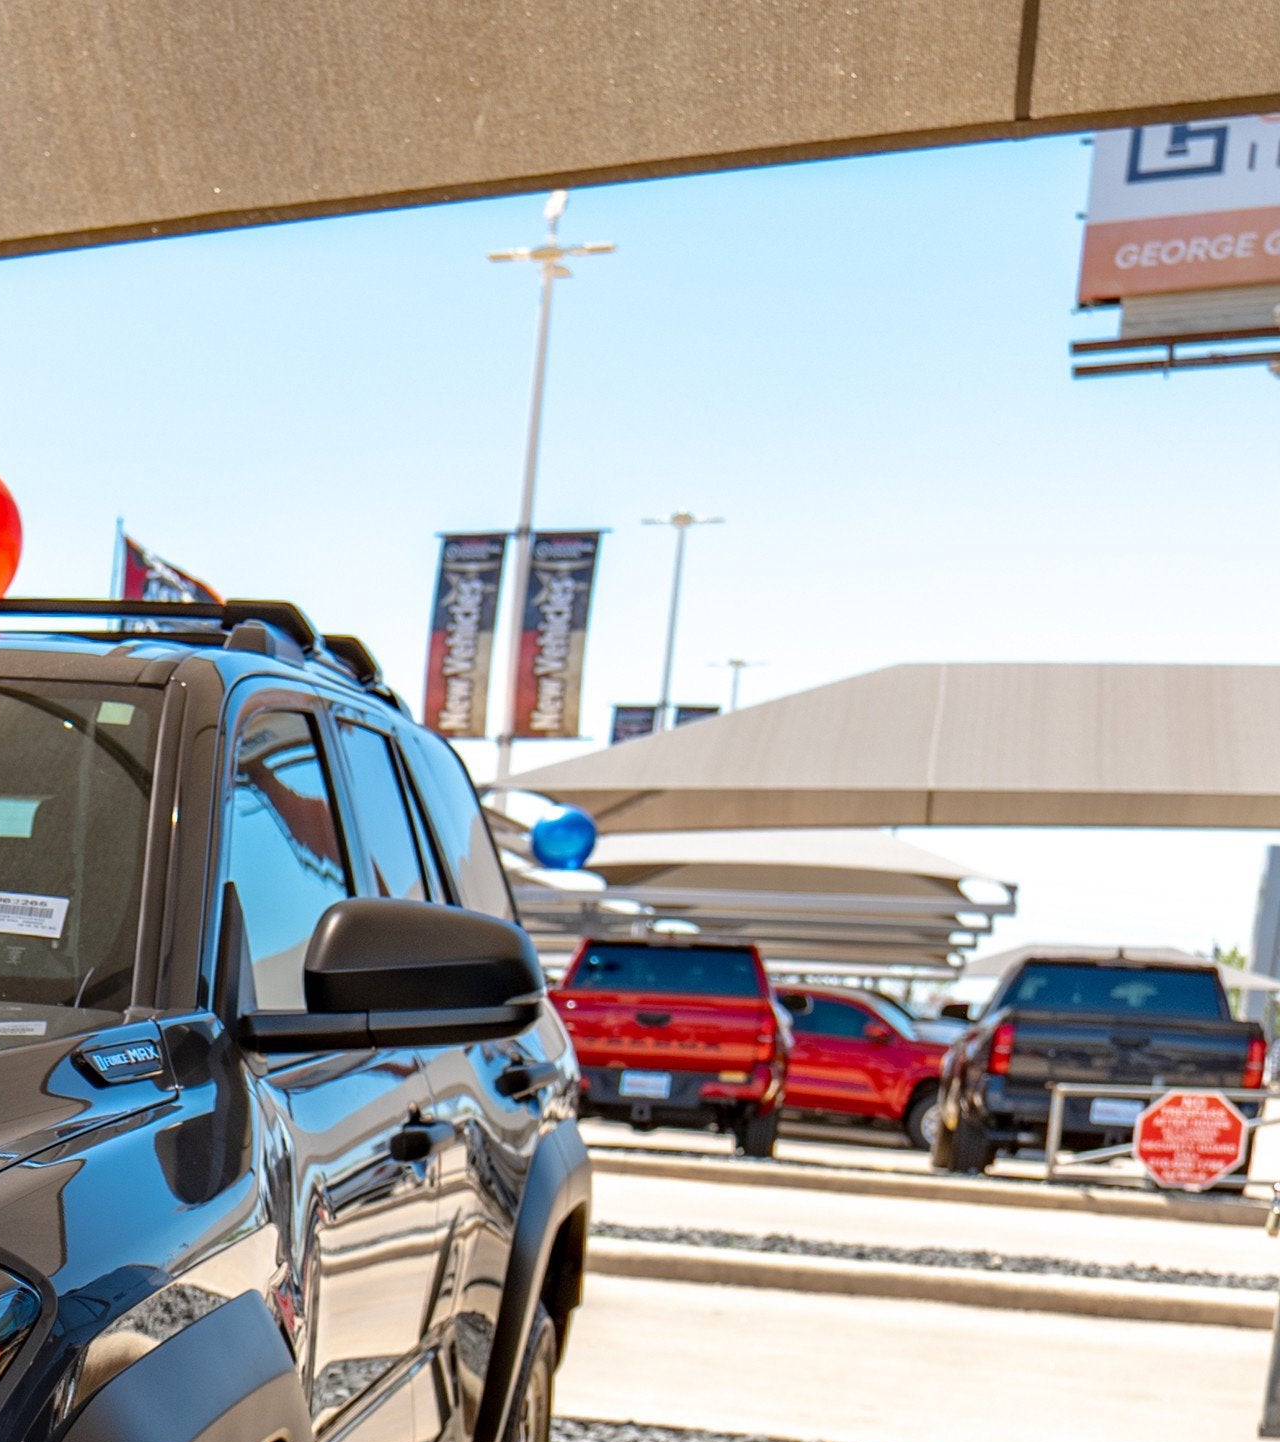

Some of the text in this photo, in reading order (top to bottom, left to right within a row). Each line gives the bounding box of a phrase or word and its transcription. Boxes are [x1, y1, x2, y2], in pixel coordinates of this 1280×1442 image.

[1114, 231, 1258, 269] GEORGE
[443, 577, 483, 676] Vehicles
[534, 576, 576, 676] Vehicles
[439, 678, 472, 730] New
[530, 678, 563, 730] New
[127, 1046, 160, 1064] MAX
